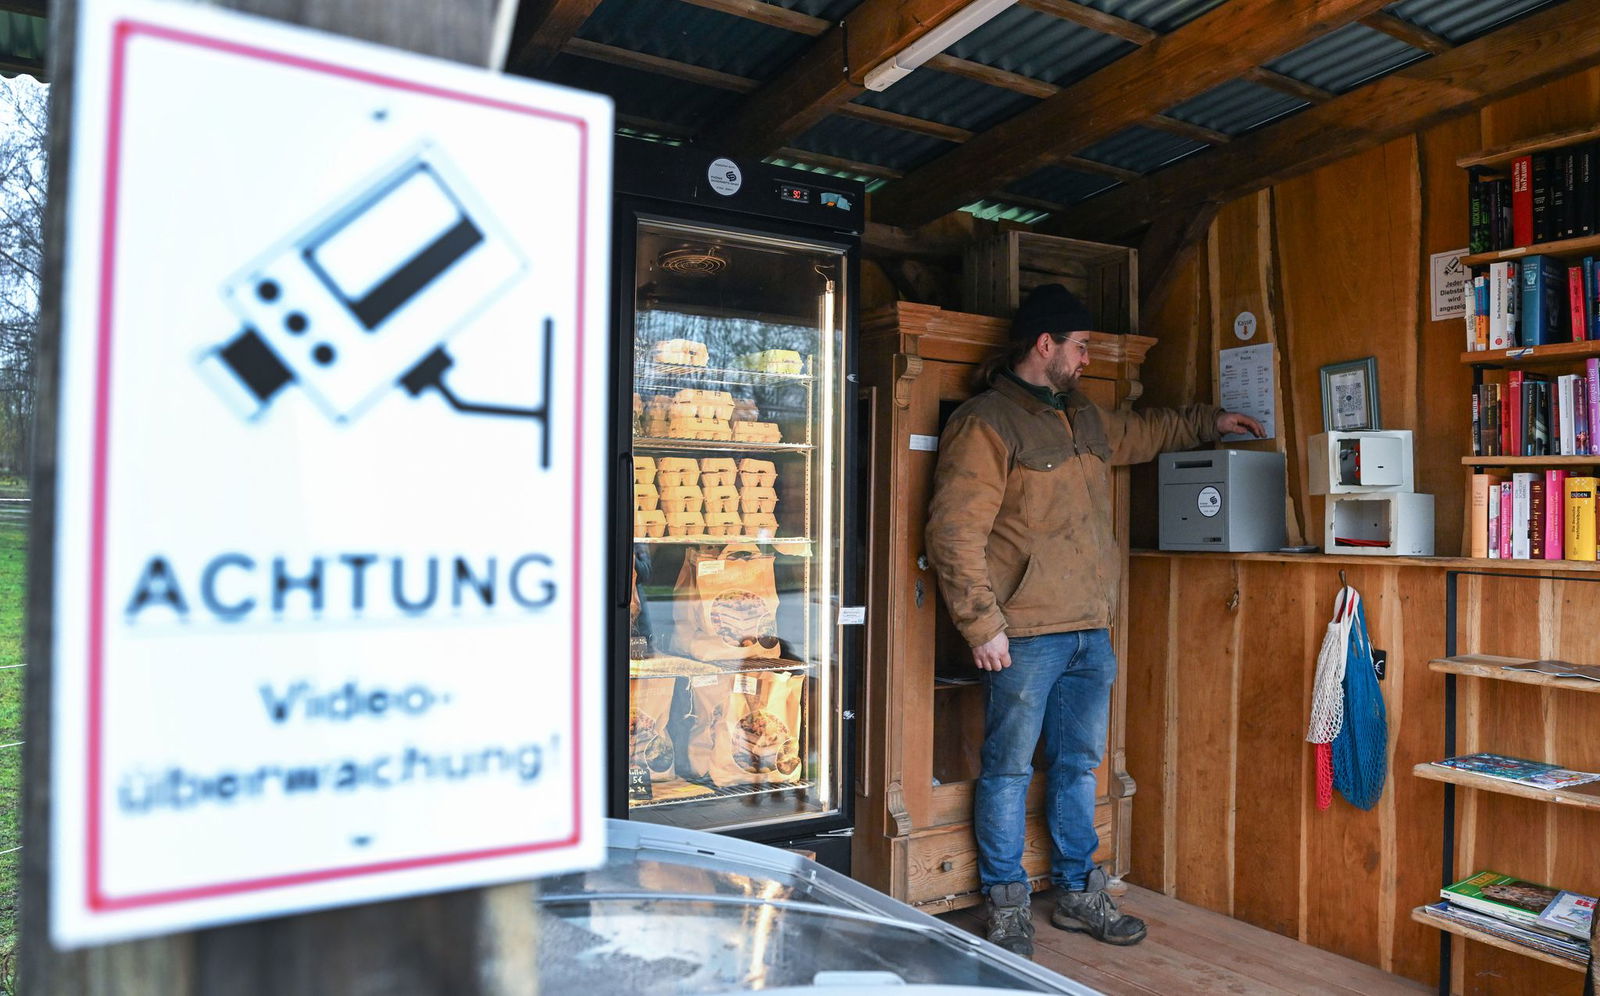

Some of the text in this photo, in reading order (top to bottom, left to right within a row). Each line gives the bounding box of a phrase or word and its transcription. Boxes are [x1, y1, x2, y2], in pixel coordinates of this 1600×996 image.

[1446, 280, 1463, 288] Jeder
[1440, 287, 1465, 296] Diebsta
[1439, 303, 1466, 312] angezeig
[125, 552, 559, 620] ACHTUNG
[259, 681, 454, 724] Video-
[118, 734, 561, 815] überwachung!
[633, 775, 644, 784] 5€
